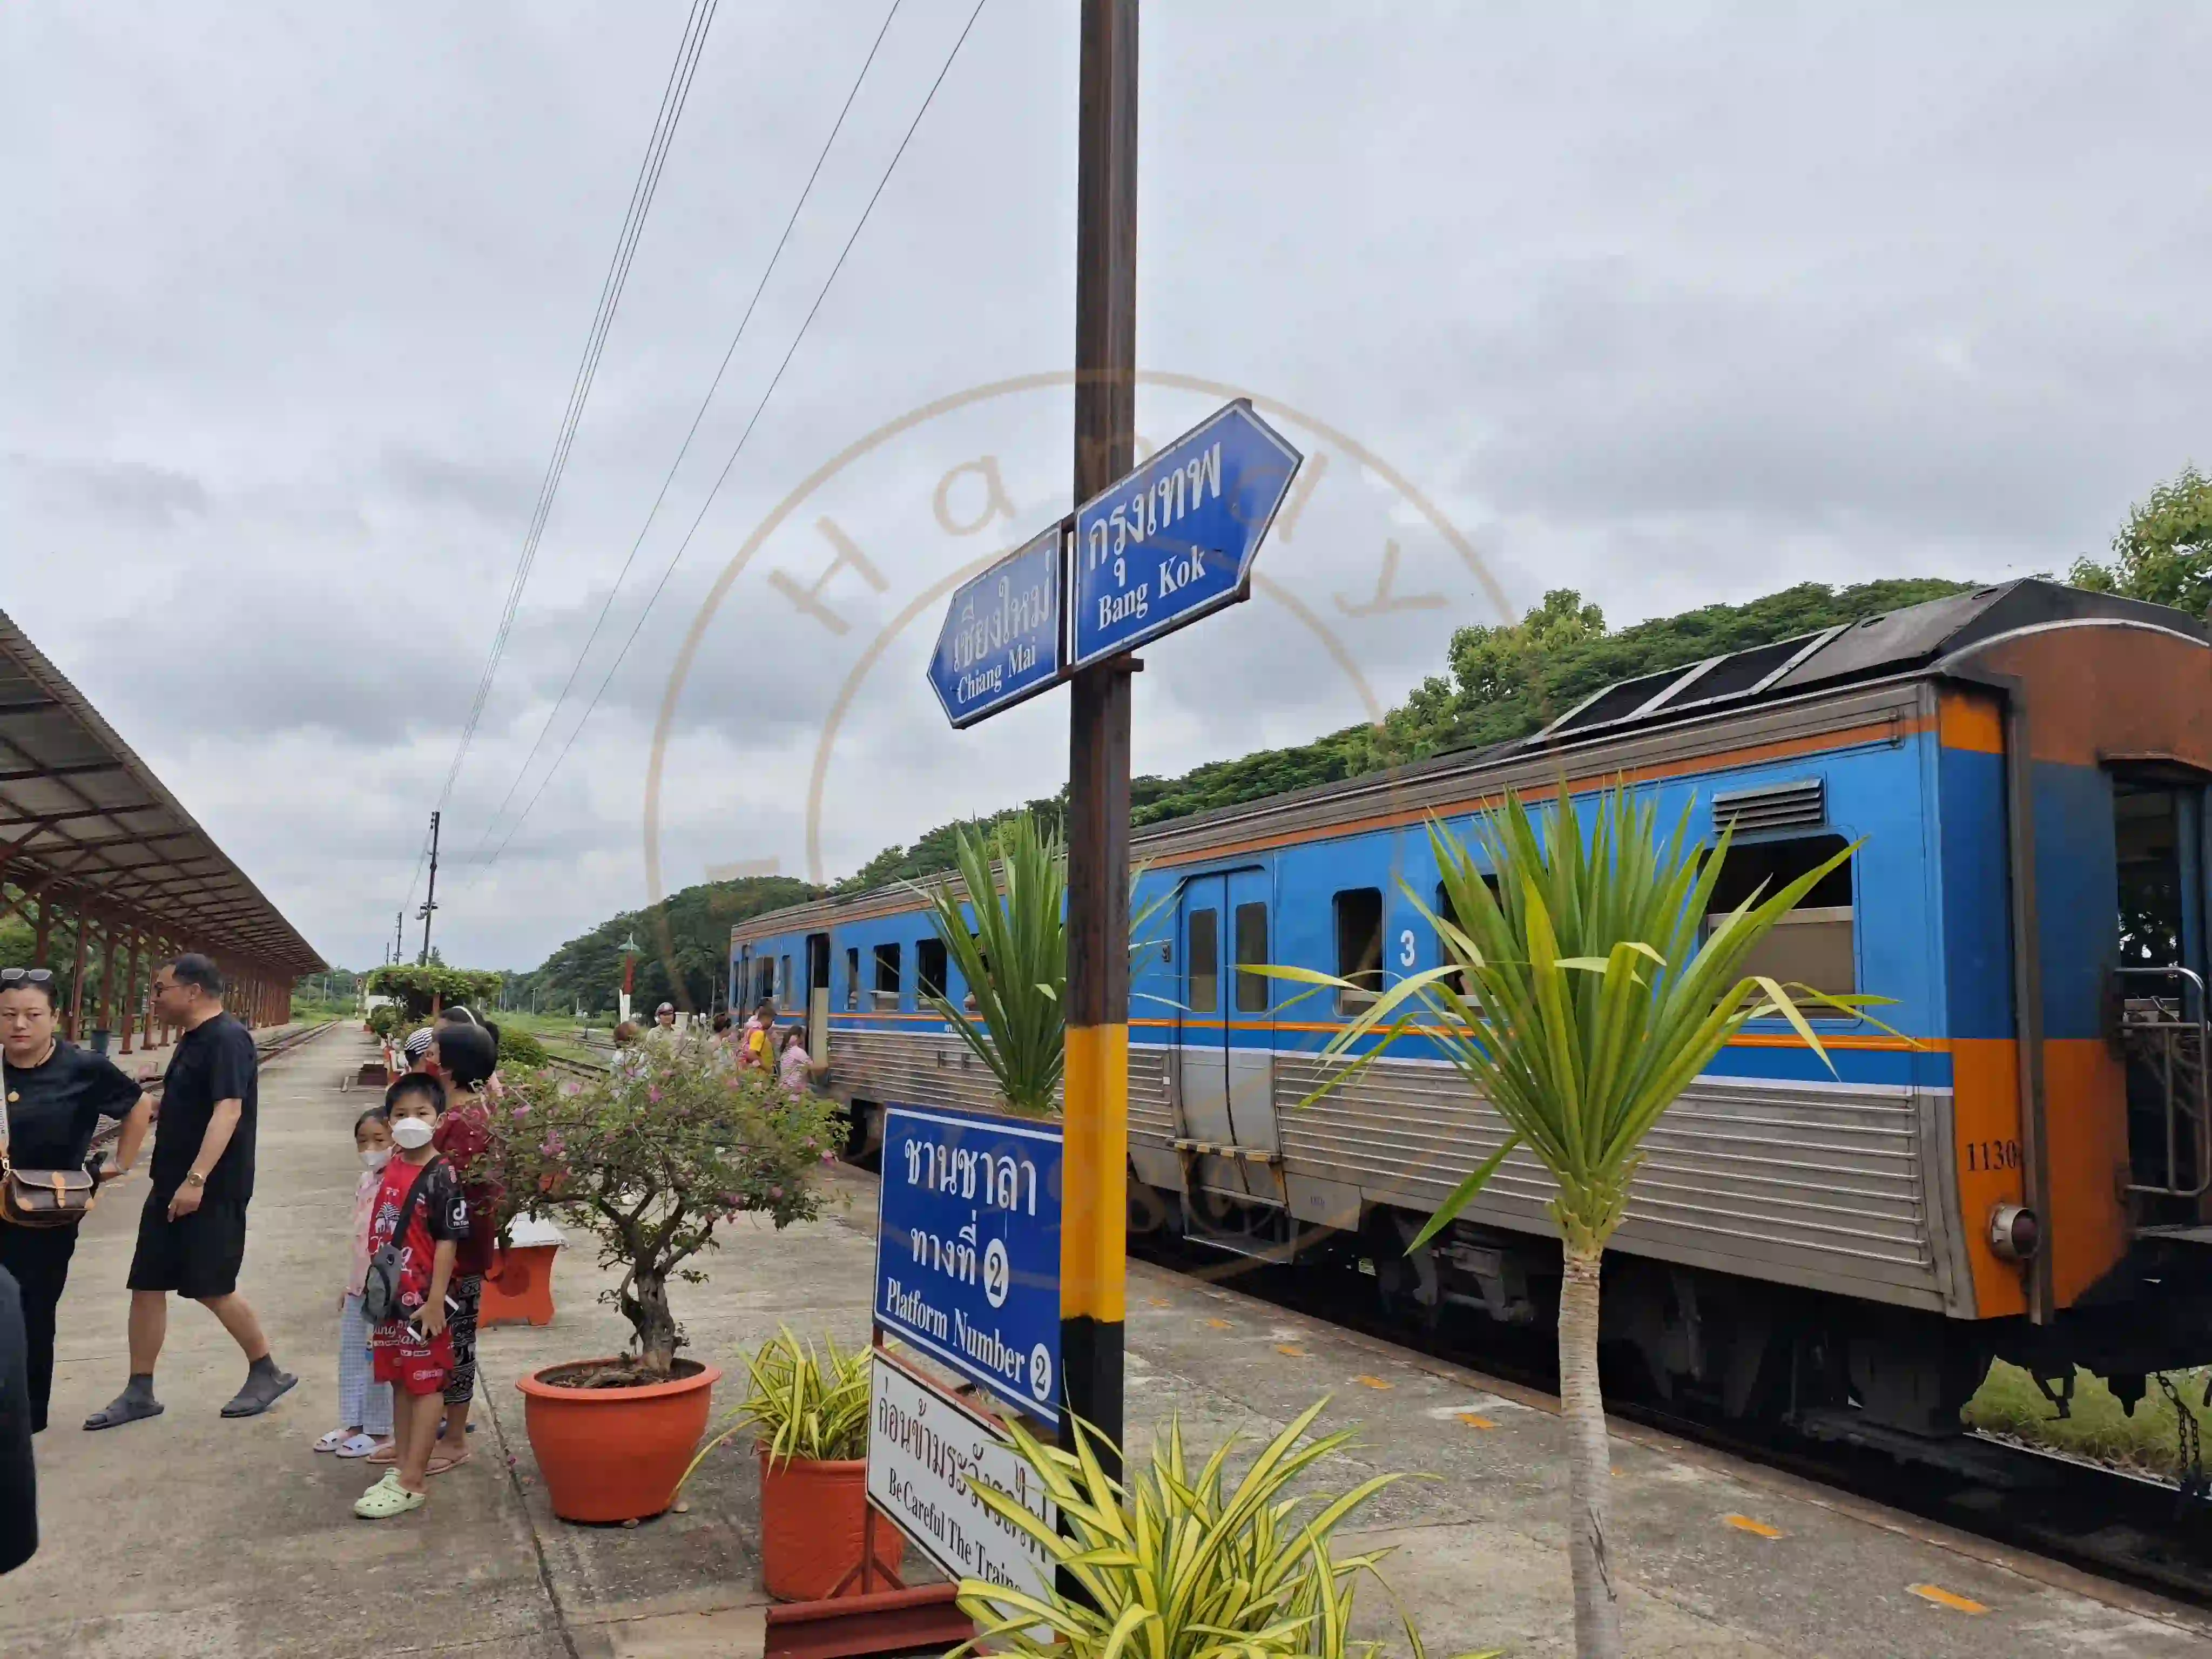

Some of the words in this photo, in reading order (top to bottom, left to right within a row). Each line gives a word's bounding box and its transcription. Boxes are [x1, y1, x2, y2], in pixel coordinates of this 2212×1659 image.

[1088, 442, 1221, 587] กรุงเทพ
[953, 549, 1051, 672] เชียงใหม่
[1097, 584, 1149, 631] Bang
[1158, 545, 1206, 598] Kok
[957, 664, 1002, 705] Chiang
[1008, 636, 1035, 679] Mai
[1400, 929, 1415, 967] 3
[905, 1138, 1036, 1216] ชานชาลา
[911, 1210, 977, 1285] ทางที่
[886, 1277, 947, 1340] Platform
[952, 1308, 1026, 1384] Number
[888, 1467, 902, 1502] Be
[903, 1481, 945, 1543] Careful
[948, 1518, 972, 1565] The
